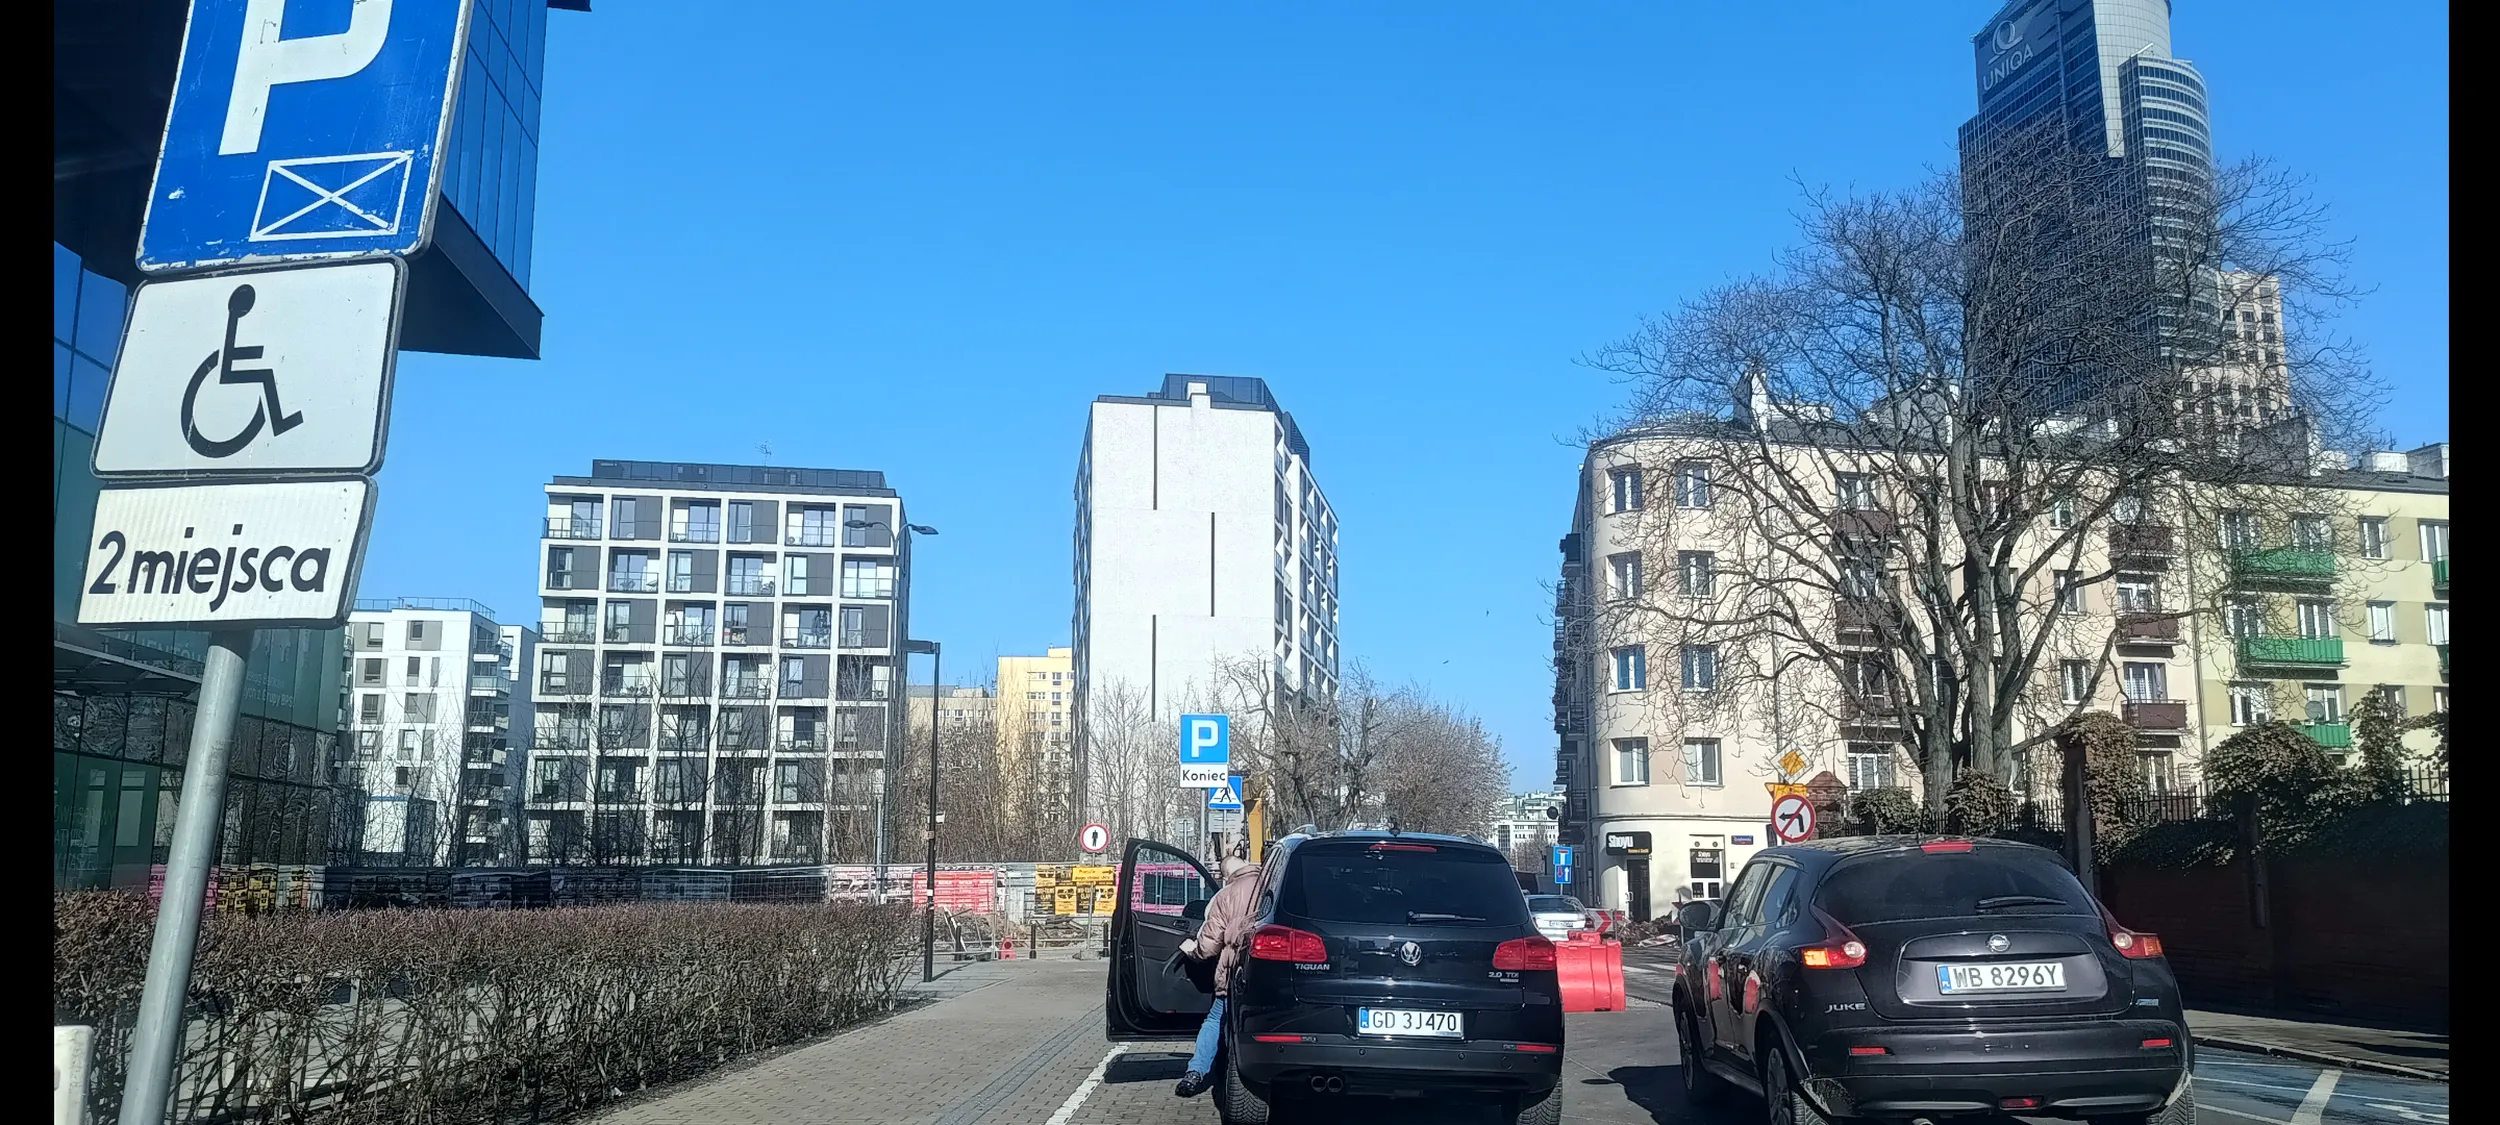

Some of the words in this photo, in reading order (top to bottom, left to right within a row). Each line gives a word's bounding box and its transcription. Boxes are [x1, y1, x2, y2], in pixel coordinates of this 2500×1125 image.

[218, 0, 393, 155] P
[1983, 43, 2034, 91] UNIQA
[89, 530, 126, 595] 2
[129, 524, 332, 612] miejsca
[1191, 719, 1219, 757] P
[1182, 769, 1226, 782] Koniec
[1608, 834, 1634, 849] Shoyu
[1294, 963, 1330, 971] TIGUAN
[1953, 967, 1983, 988] WB
[1990, 965, 2056, 987] 8296Y
[1824, 1002, 1866, 1014] JUKE
[1373, 1011, 1395, 1029] GD
[1403, 1012, 1457, 1031] 3J470
